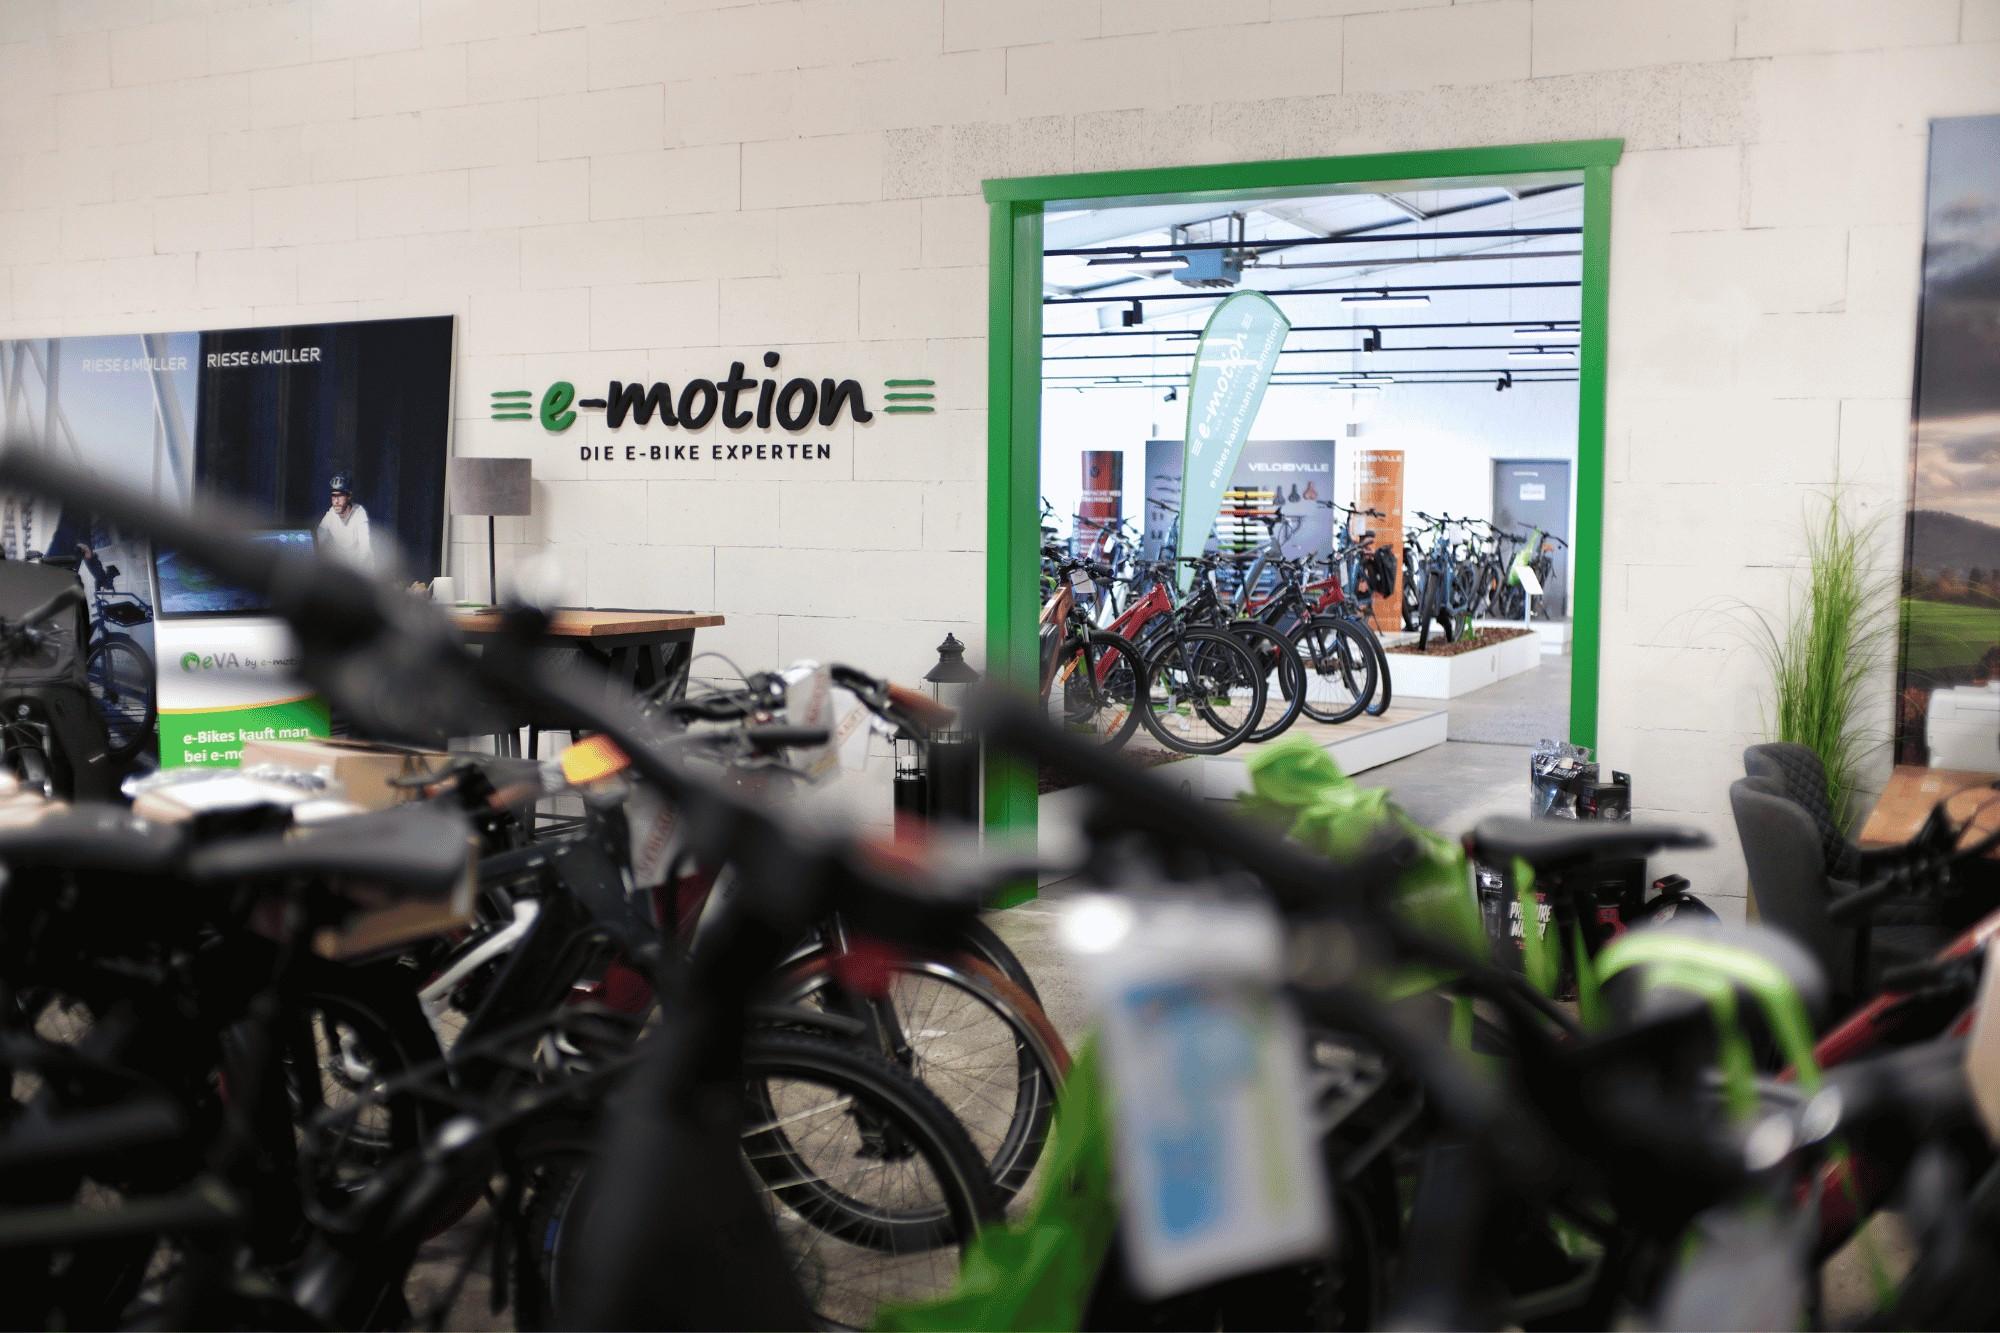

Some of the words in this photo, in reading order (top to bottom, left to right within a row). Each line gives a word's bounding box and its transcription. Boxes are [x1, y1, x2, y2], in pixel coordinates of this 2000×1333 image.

[540, 351, 874, 432] e-motion
[1209, 447, 1231, 489] e-Bikes
[1224, 413, 1245, 449] kauft
[1236, 389, 1253, 416] man
[580, 446, 615, 461] DIE
[625, 445, 700, 460] E-BIKE
[712, 443, 832, 460] EXPERTEN
[202, 653, 240, 670] eVA
[244, 658, 257, 669] by
[183, 730, 236, 745] e-Bikes
[239, 727, 276, 741] kauft
[278, 728, 310, 739] man
[184, 750, 208, 763] bei
